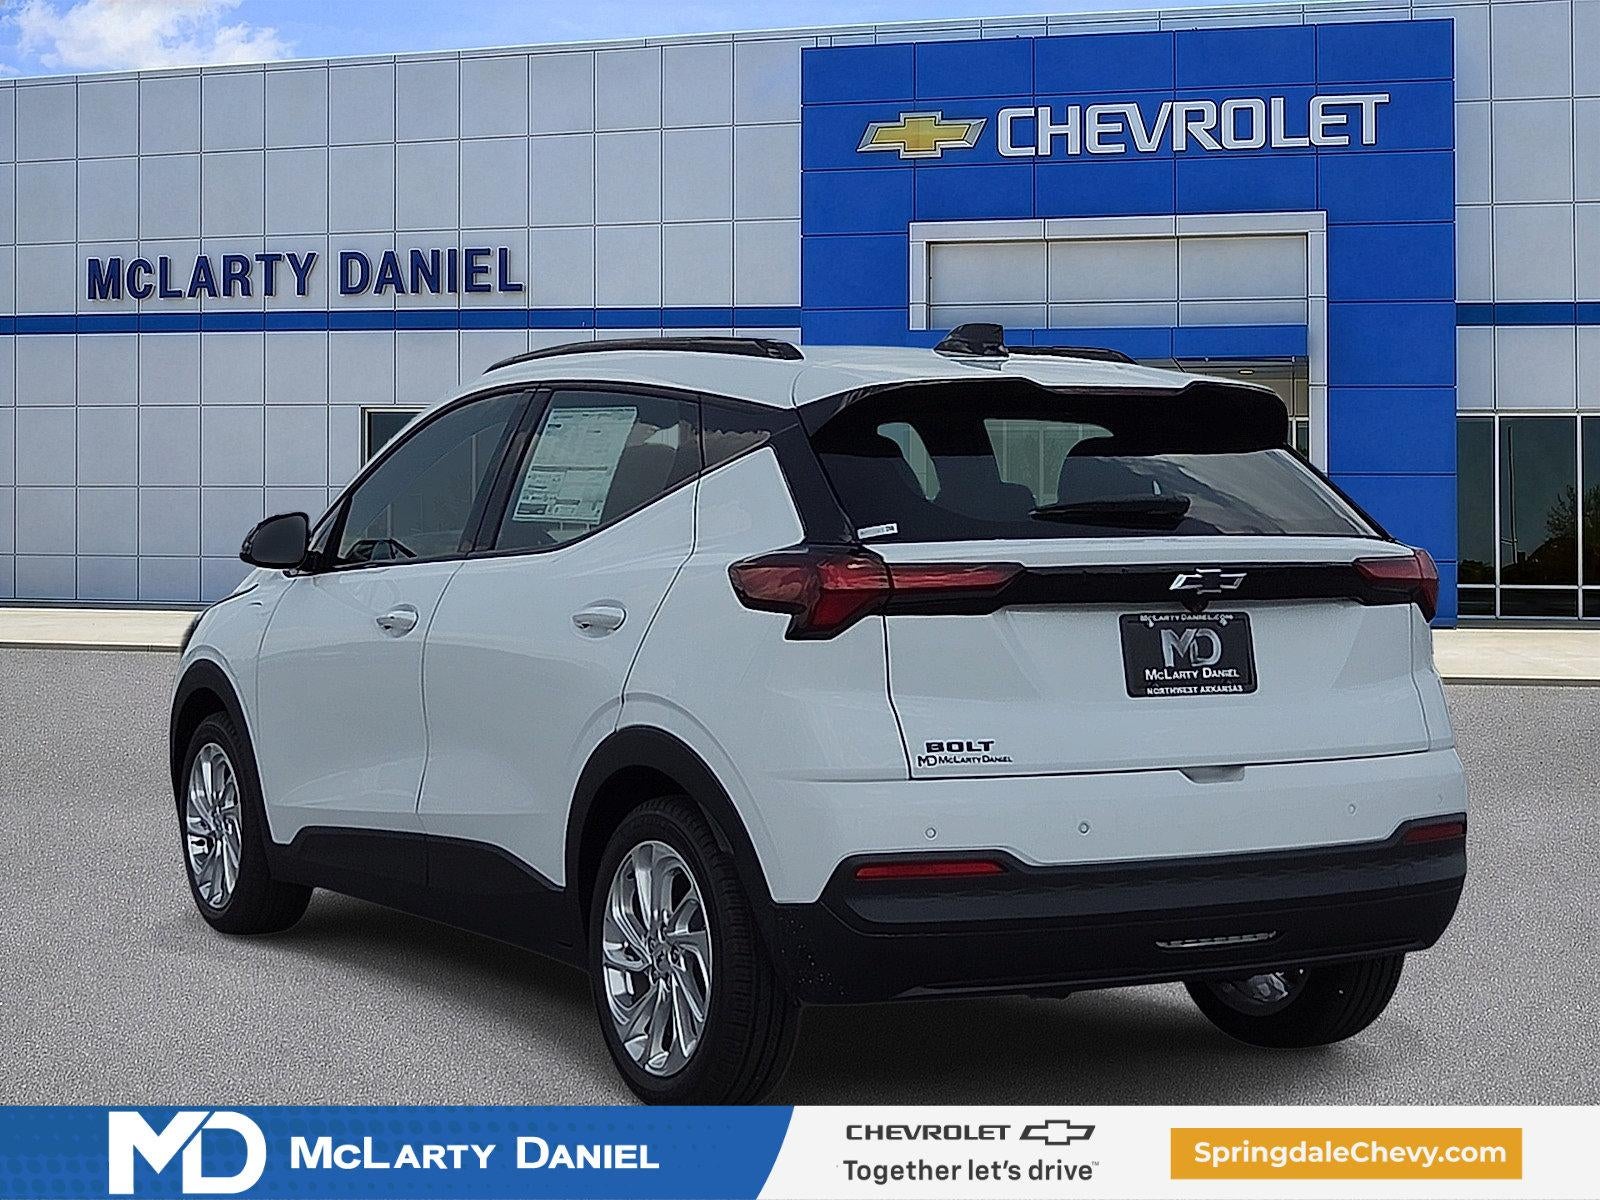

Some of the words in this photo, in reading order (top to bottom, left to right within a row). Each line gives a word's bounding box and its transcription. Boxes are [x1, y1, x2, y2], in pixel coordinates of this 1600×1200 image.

[996, 93, 1390, 158] CHEVROLET
[86, 251, 318, 300] MCLARTY
[339, 246, 525, 296] DANIEL
[1160, 628, 1222, 667] MD
[925, 740, 994, 753] BOLT
